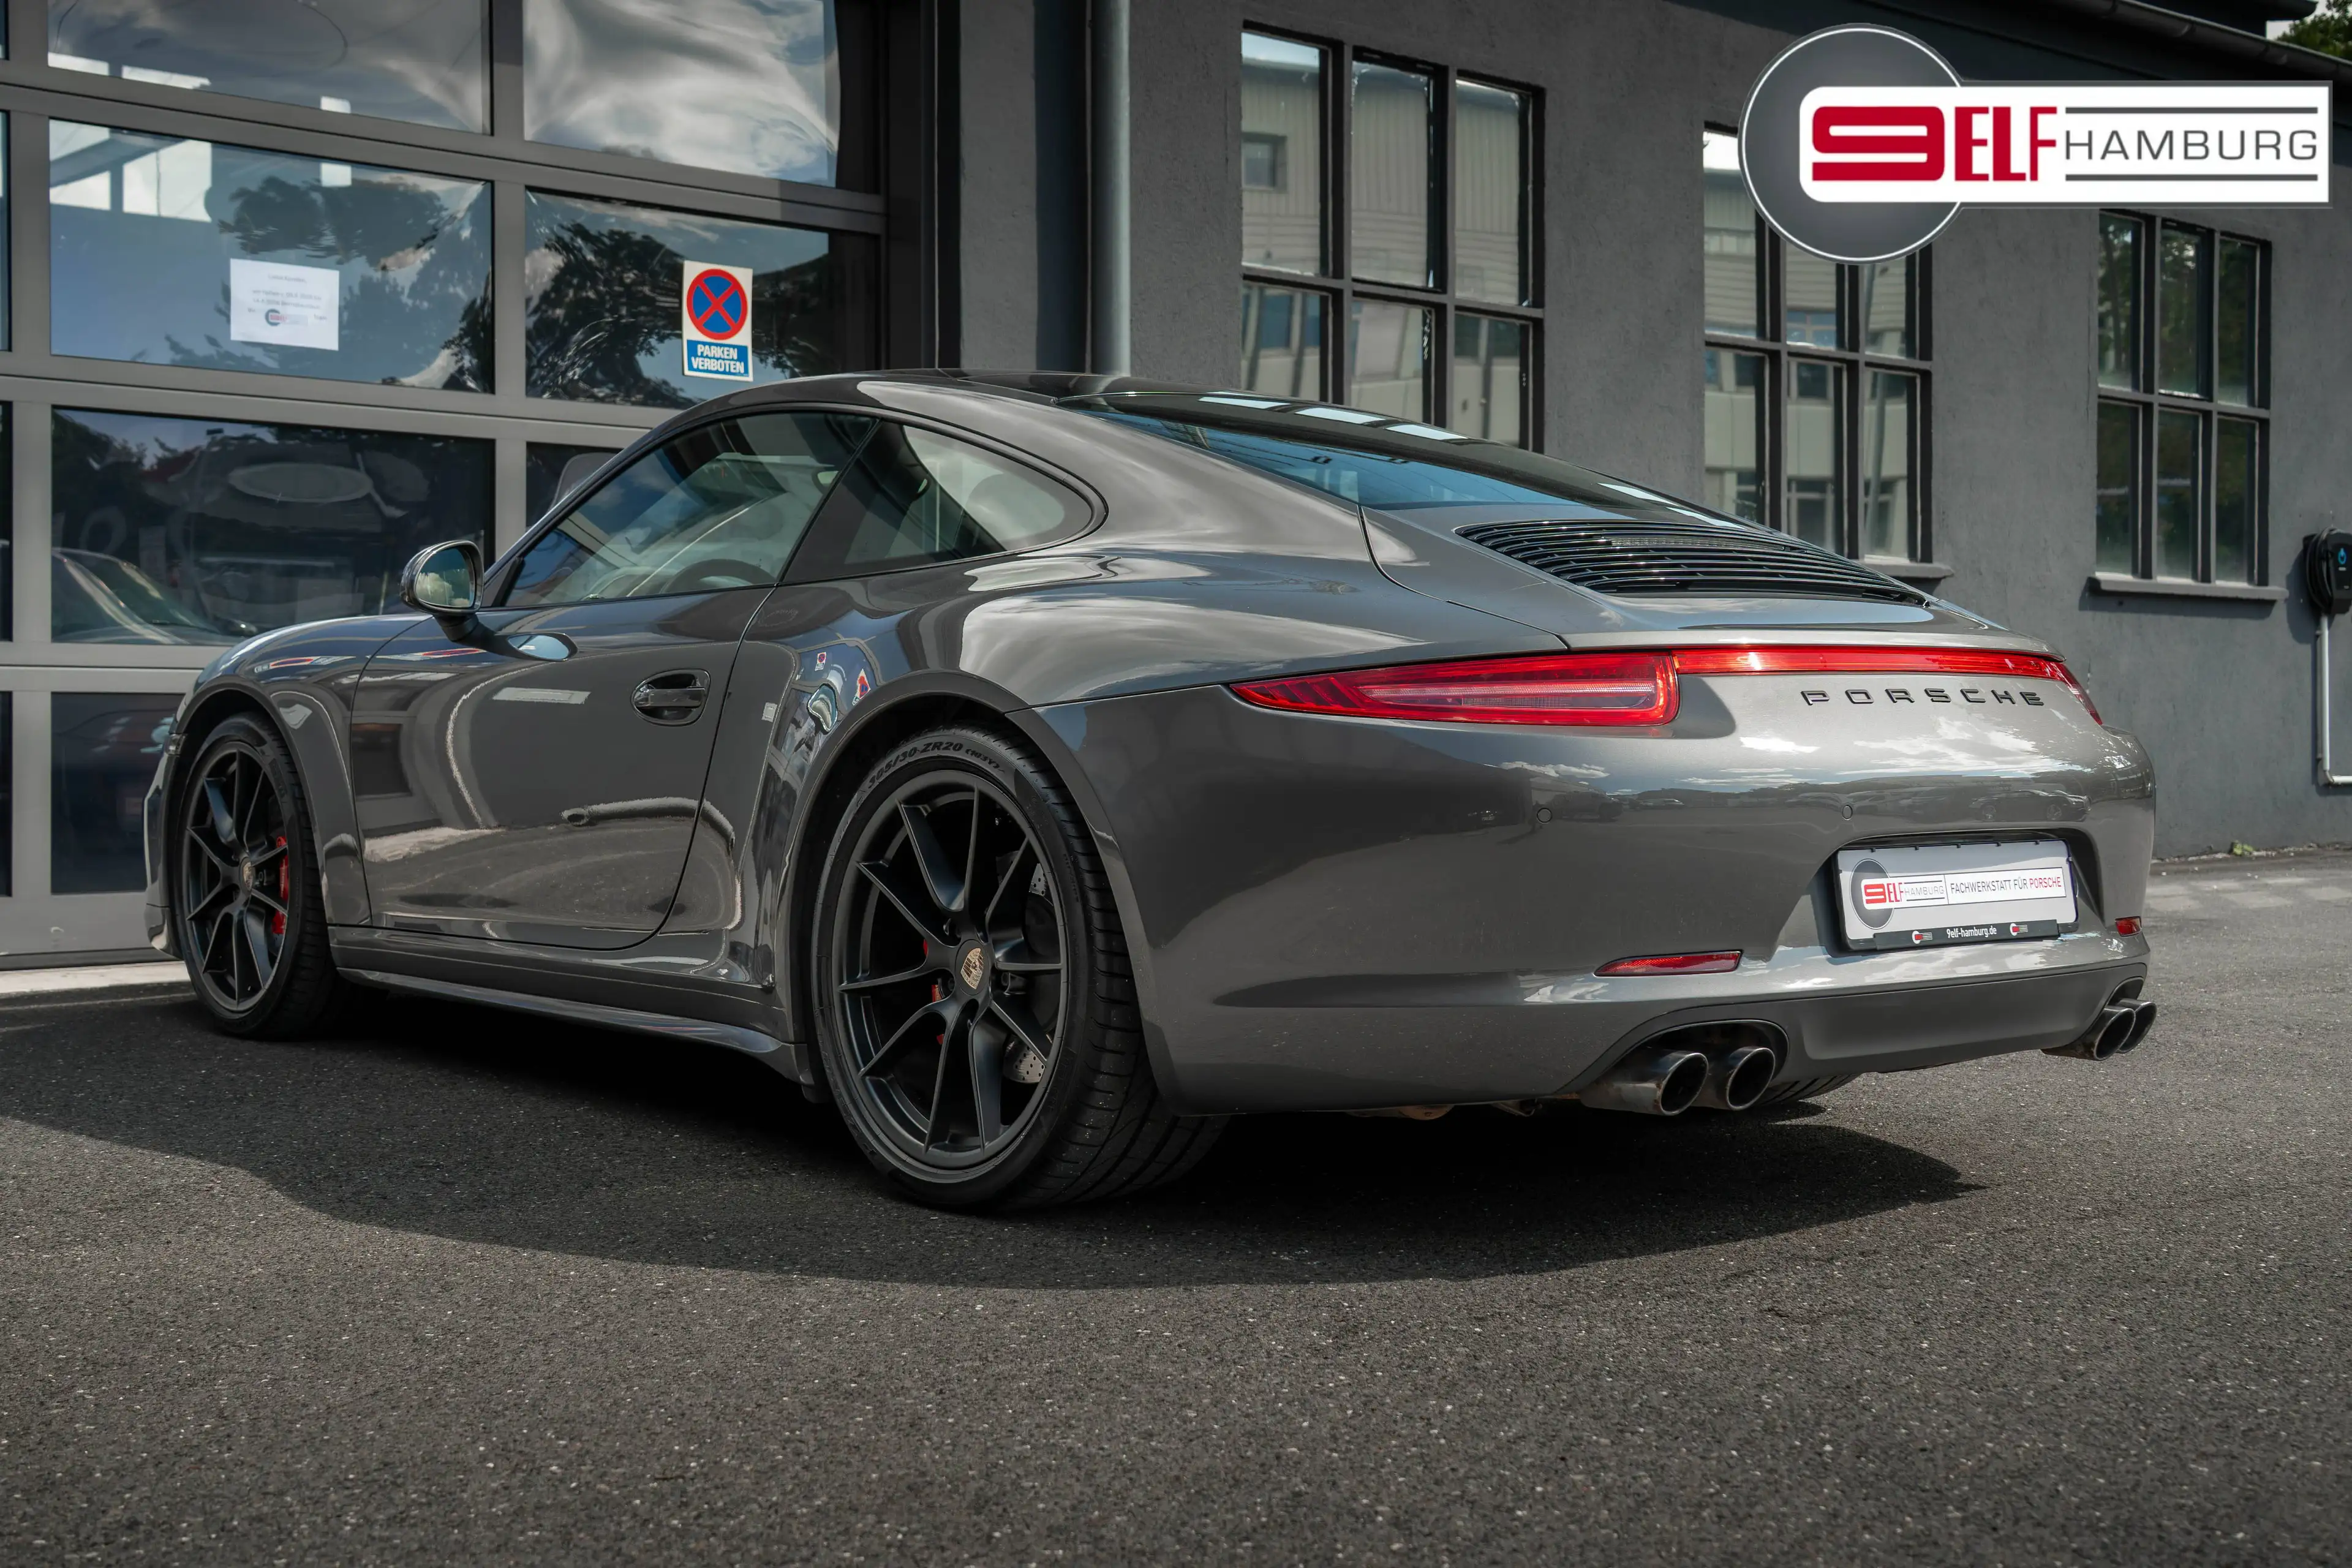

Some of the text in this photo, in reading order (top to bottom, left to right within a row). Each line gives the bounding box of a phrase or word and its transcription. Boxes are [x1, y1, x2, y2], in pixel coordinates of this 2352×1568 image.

[696, 344, 737, 360] PARKEN
[691, 356, 745, 374] VERBOTEN
[1801, 688, 2044, 706] PORSCHE
[920, 741, 963, 754] ZR20
[1904, 886, 1944, 896] HAMBURG
[1950, 876, 2062, 894] FACHWERKSTATT FÜR PORSCHE
[1946, 925, 1997, 938] 9elf-hamburg.de
